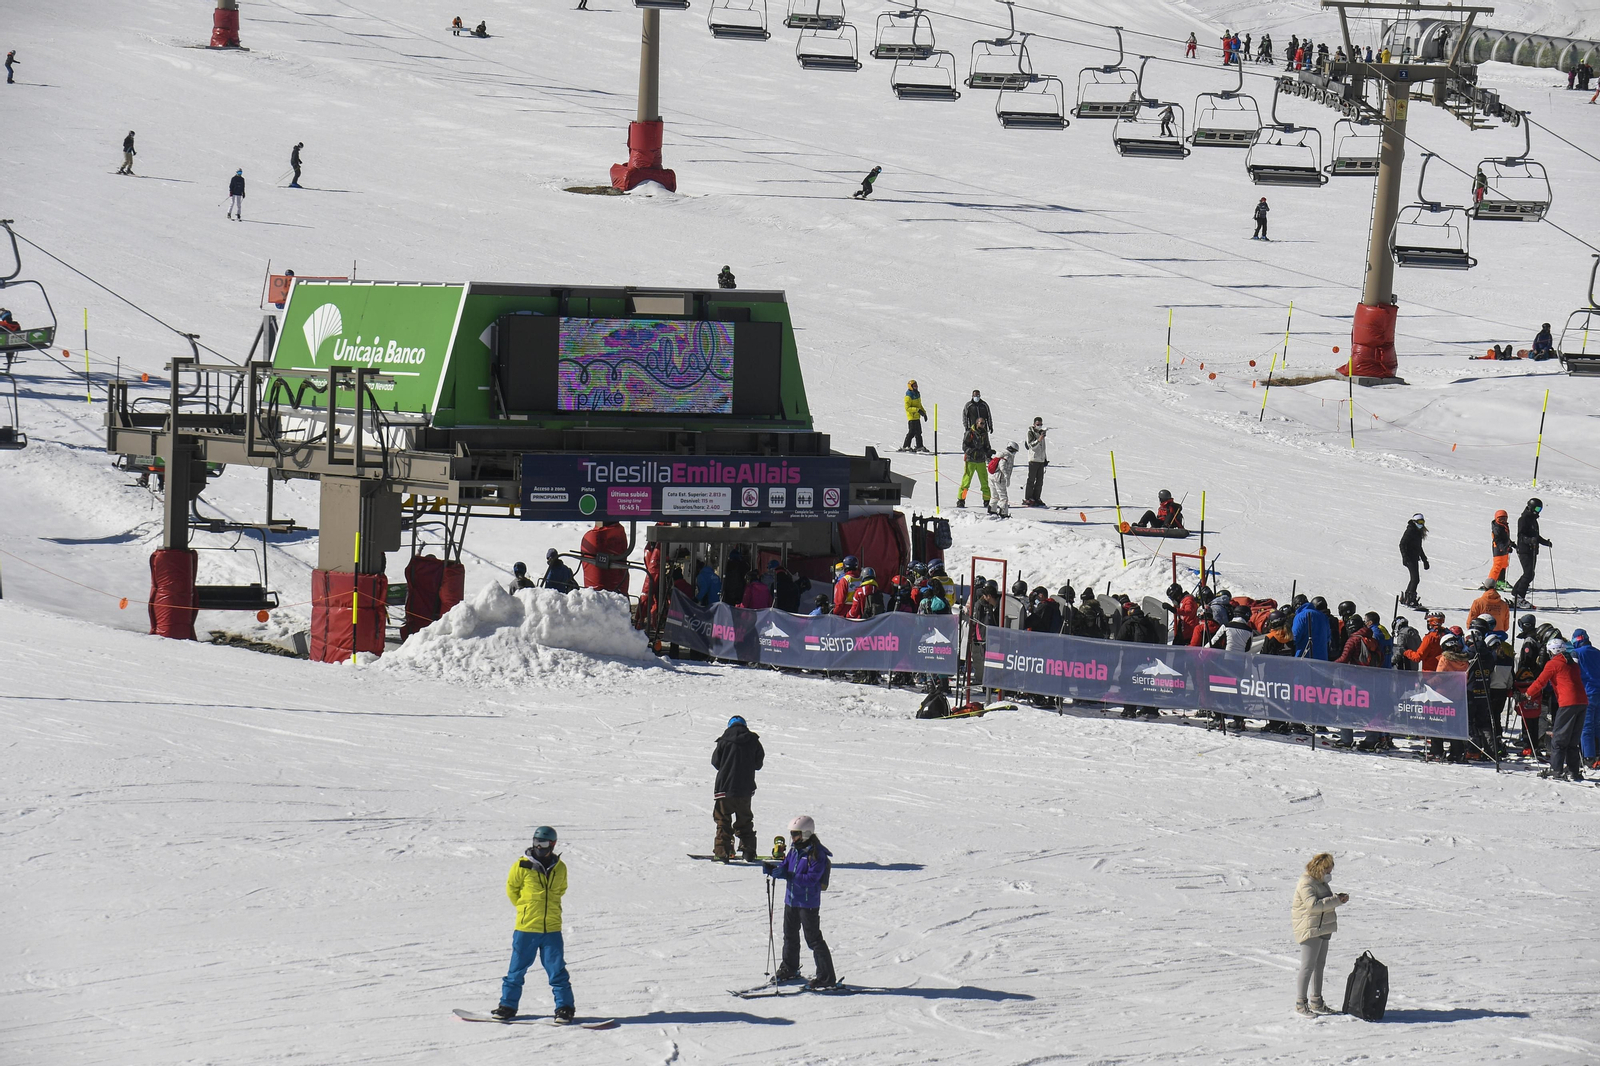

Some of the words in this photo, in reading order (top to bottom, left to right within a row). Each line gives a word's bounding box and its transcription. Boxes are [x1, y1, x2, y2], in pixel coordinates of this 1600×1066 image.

[333, 335, 384, 368] Unicaja
[384, 340, 426, 365] Banco
[610, 489, 628, 498] Última
[629, 490, 649, 498] subida
[683, 613, 712, 637] sierra
[820, 634, 854, 652] sierra
[853, 632, 899, 652] nevada
[1005, 649, 1044, 674] sierra
[1045, 657, 1108, 681] nevada
[1239, 674, 1291, 701] sierra
[1293, 684, 1370, 709] nevada
